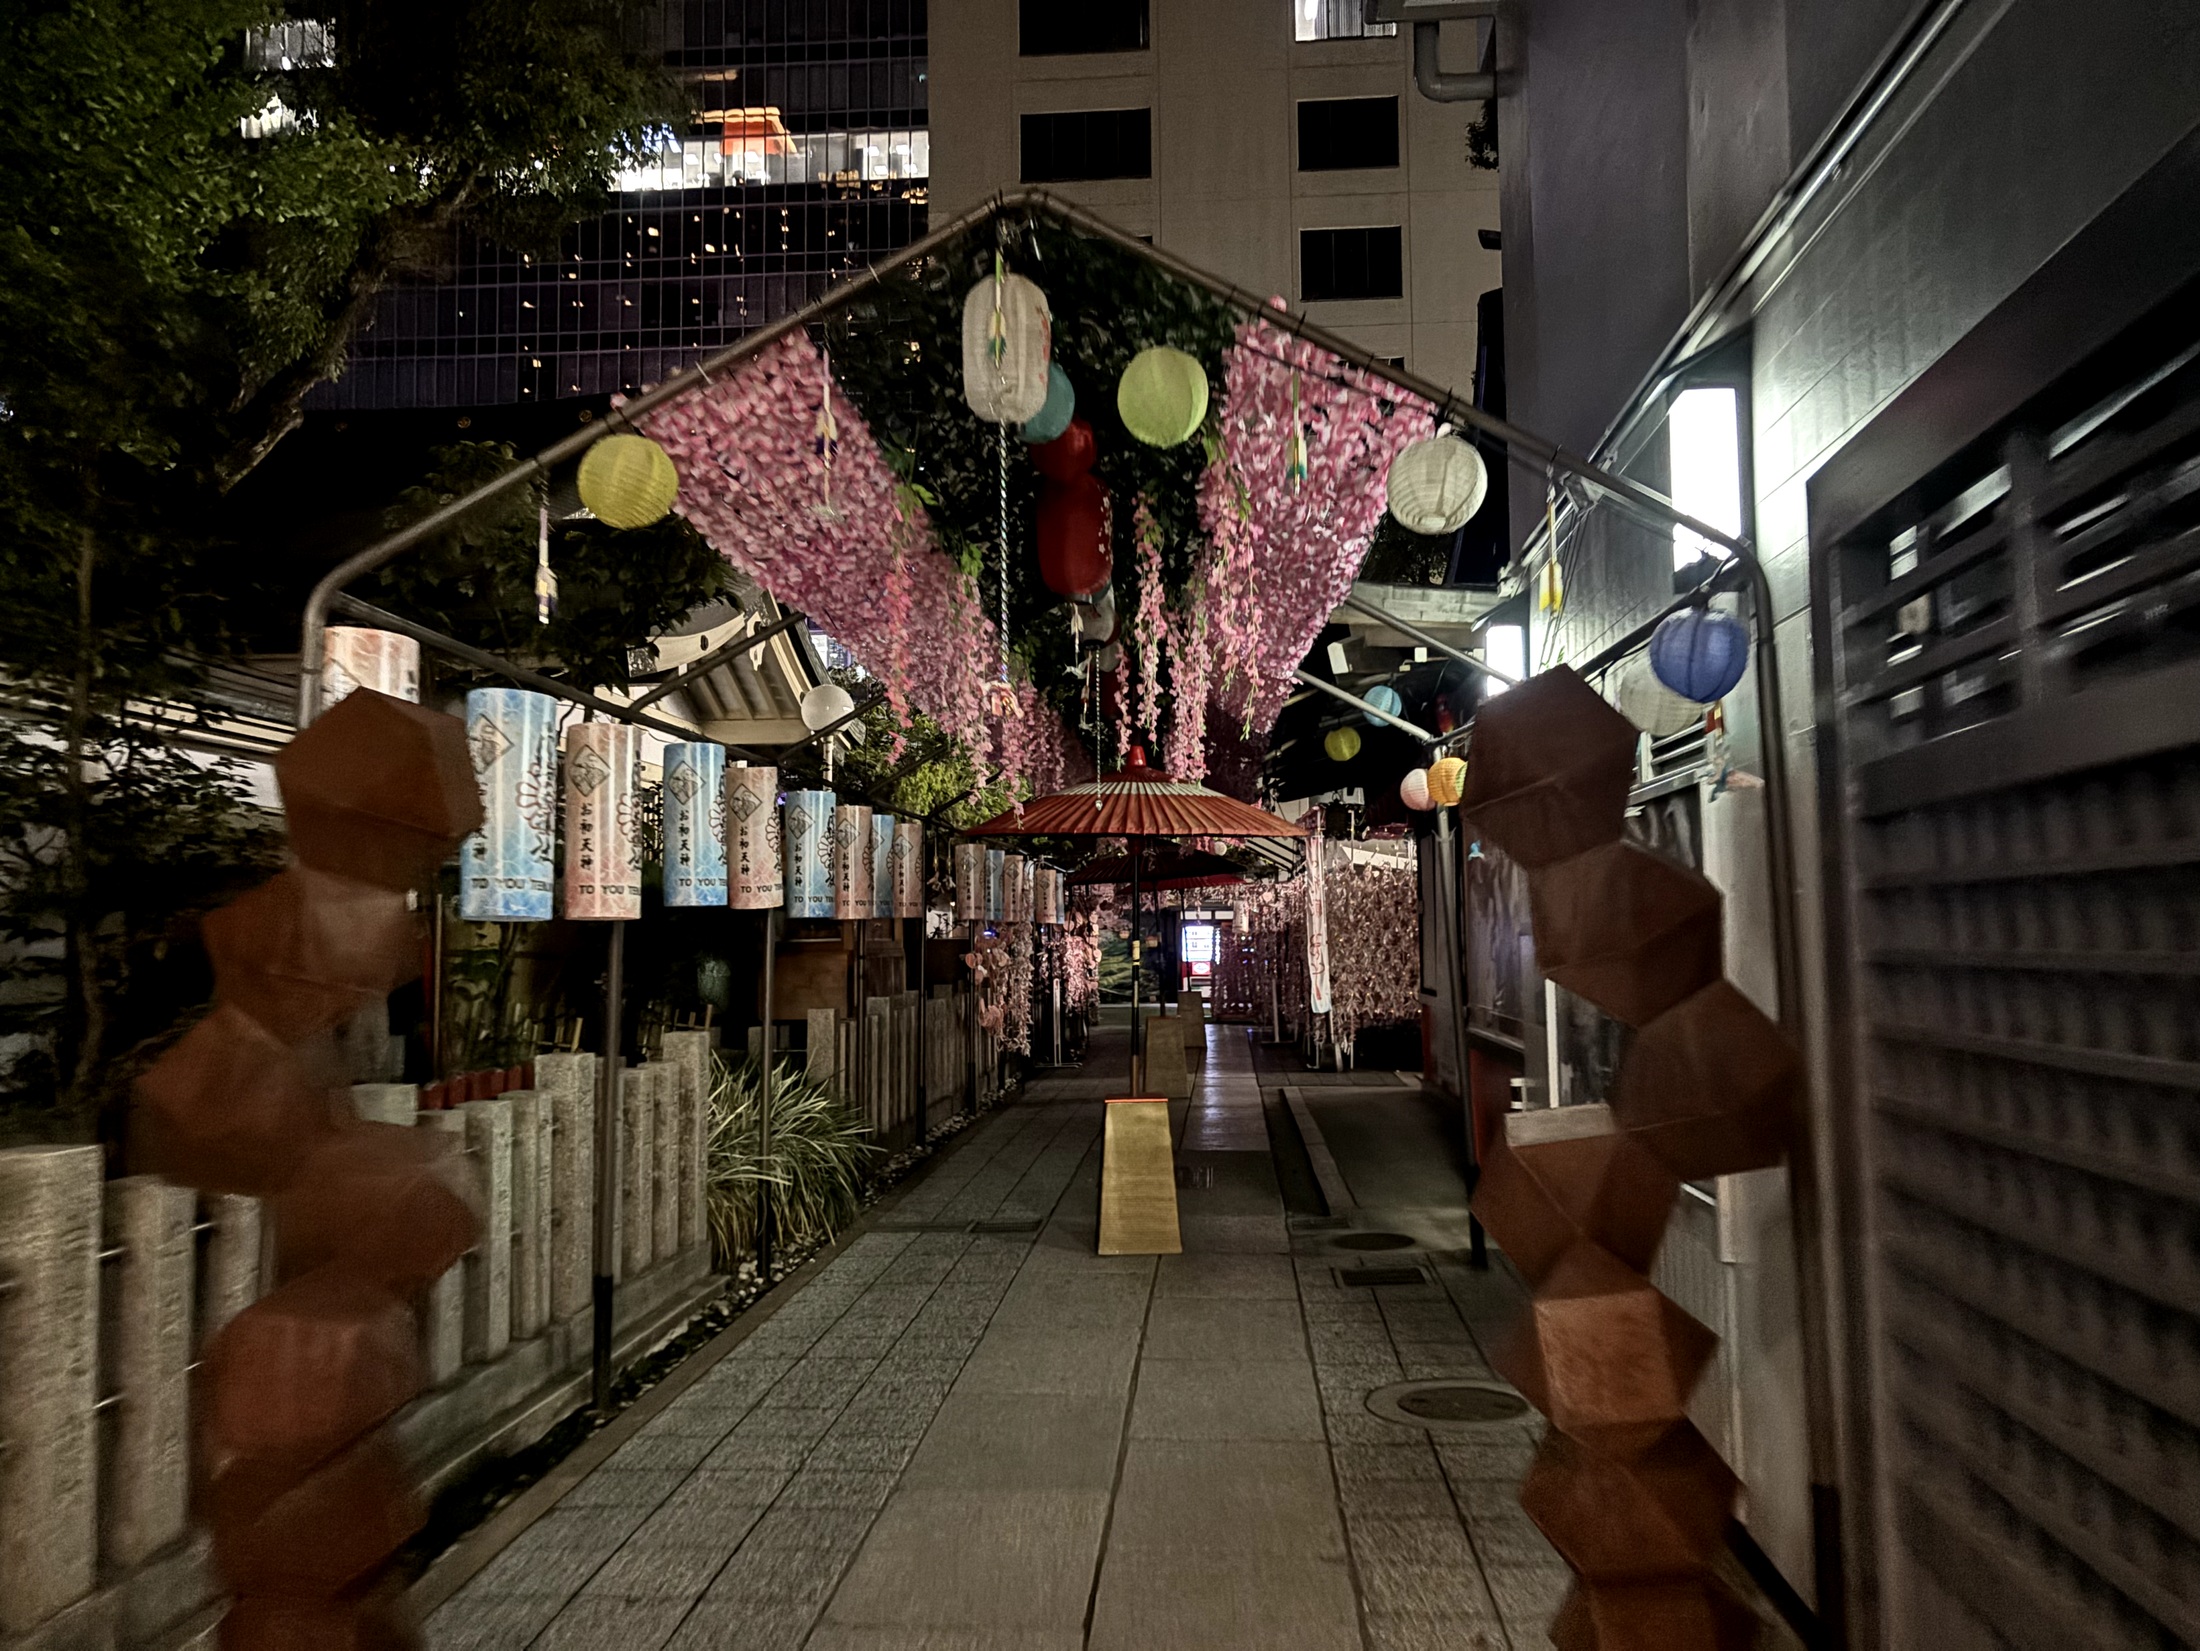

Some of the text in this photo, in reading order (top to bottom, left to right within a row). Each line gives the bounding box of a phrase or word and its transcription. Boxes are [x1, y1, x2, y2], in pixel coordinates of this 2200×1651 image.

[579, 803, 594, 871] お初天神
[679, 809, 690, 866] お初天神
[740, 826, 750, 876] お初天神
[794, 843, 803, 887] お初天神
[579, 885, 595, 894] TO
[601, 885, 625, 894] YOU
[679, 878, 692, 887] TO
[697, 878, 716, 887] YOU
[740, 885, 752, 893] TO
[756, 885, 773, 893] YOU
[794, 895, 803, 903] TO
[808, 895, 822, 903] YOU
